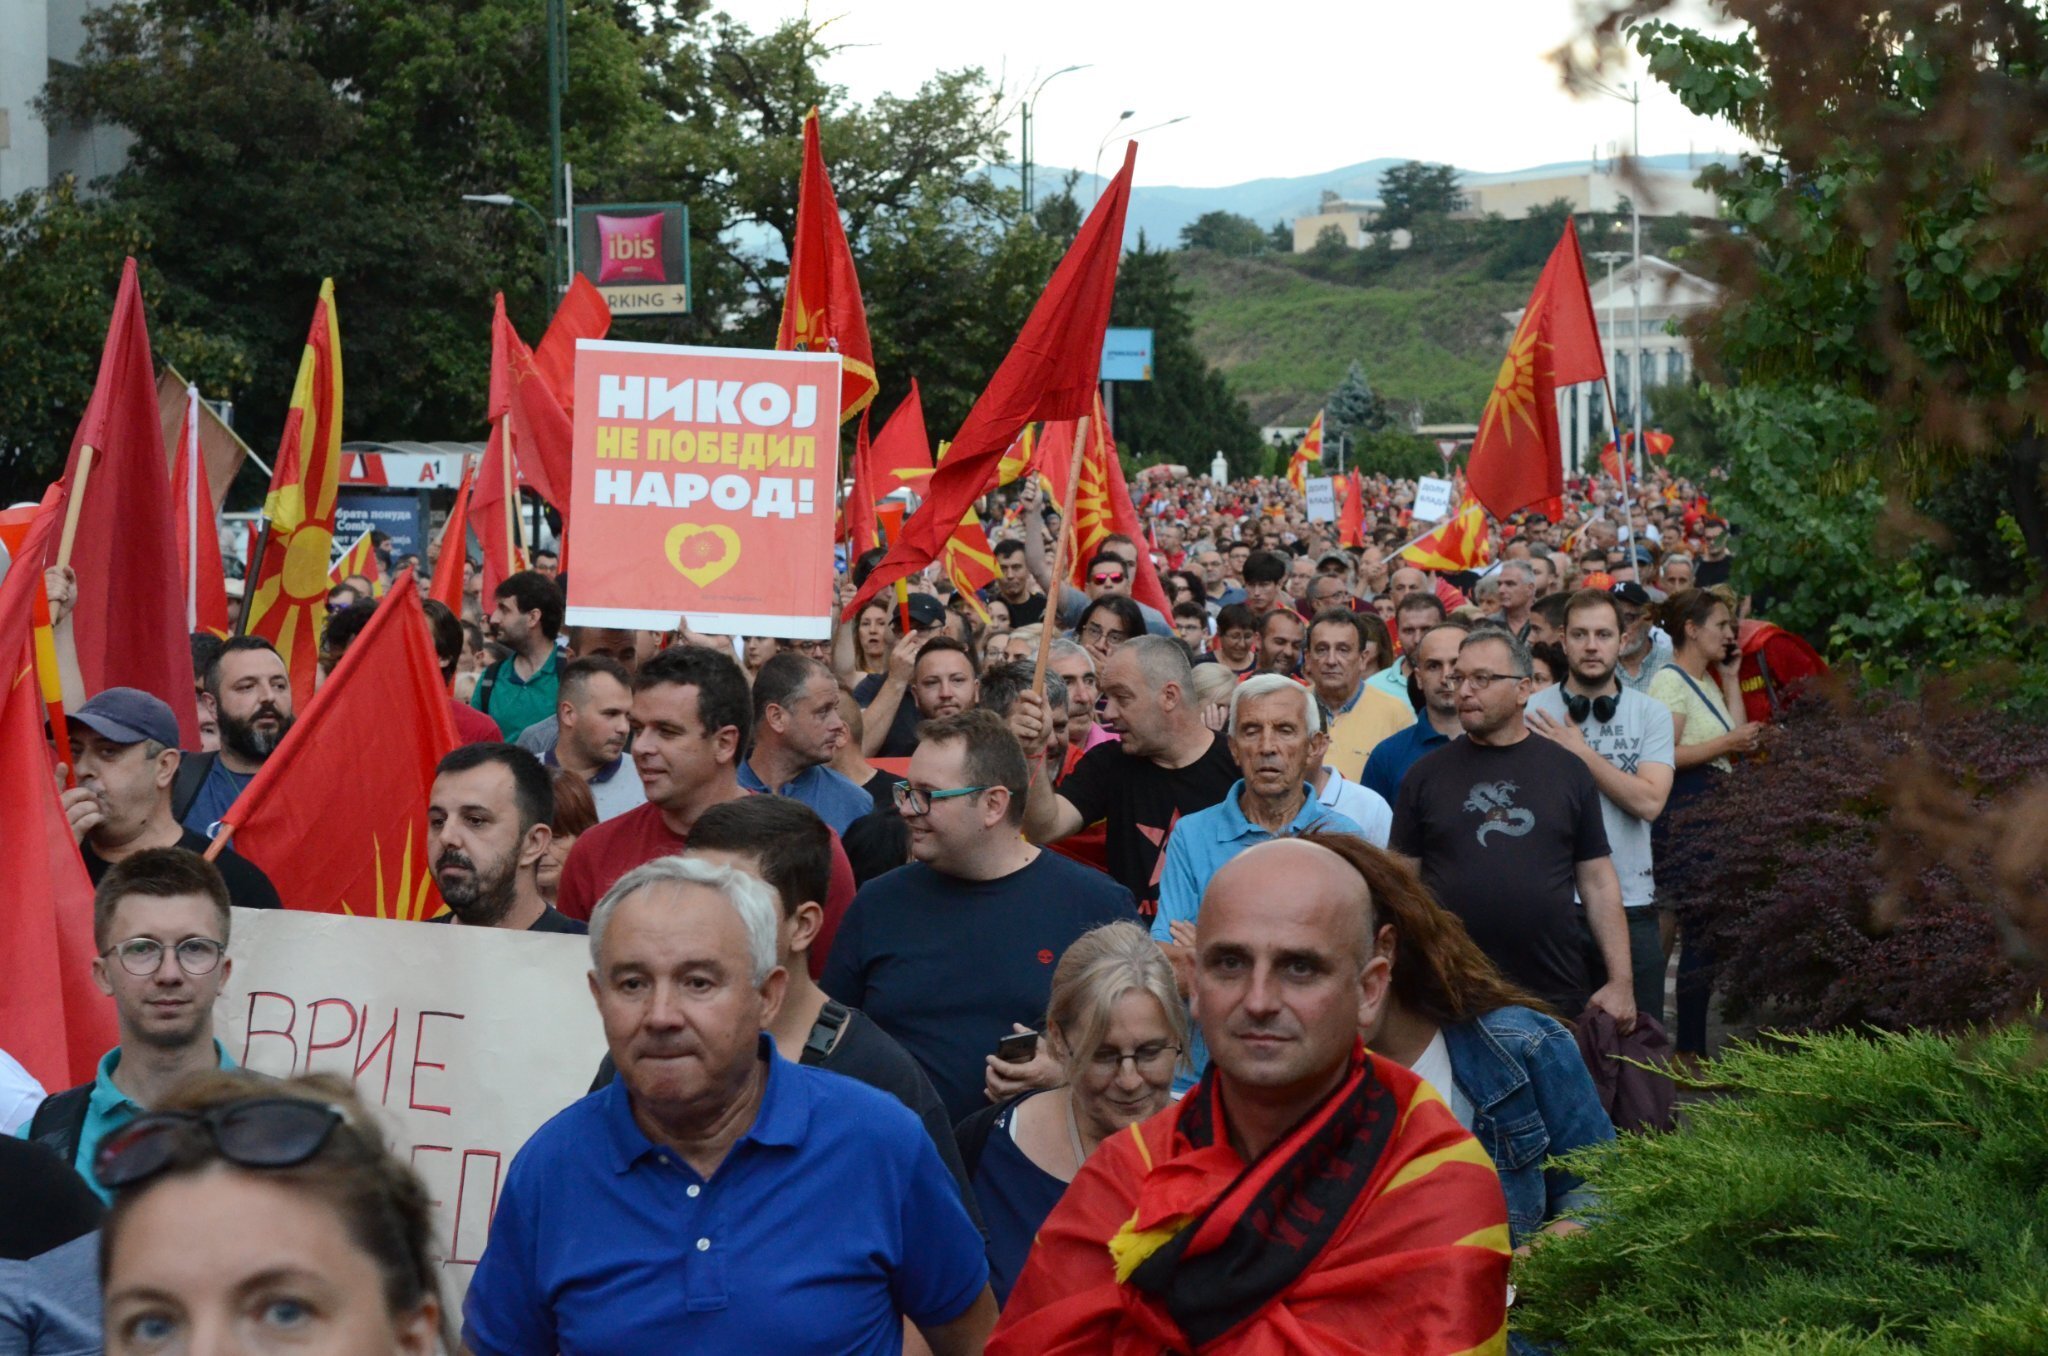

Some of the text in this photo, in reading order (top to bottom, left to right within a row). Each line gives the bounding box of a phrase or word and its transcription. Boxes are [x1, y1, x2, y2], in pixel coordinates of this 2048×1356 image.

[609, 233, 655, 259] ibis
[608, 293, 664, 307] RKING
[598, 374, 817, 428] НИКОЈ
[596, 426, 816, 471] НЕ ПОБЕДИЛ
[594, 469, 815, 519] НАРОД!
[335, 508, 368, 520] брата
[336, 520, 375, 531] Combo
[1600, 725, 1624, 736] ME
[1613, 737, 1640, 750] MY
